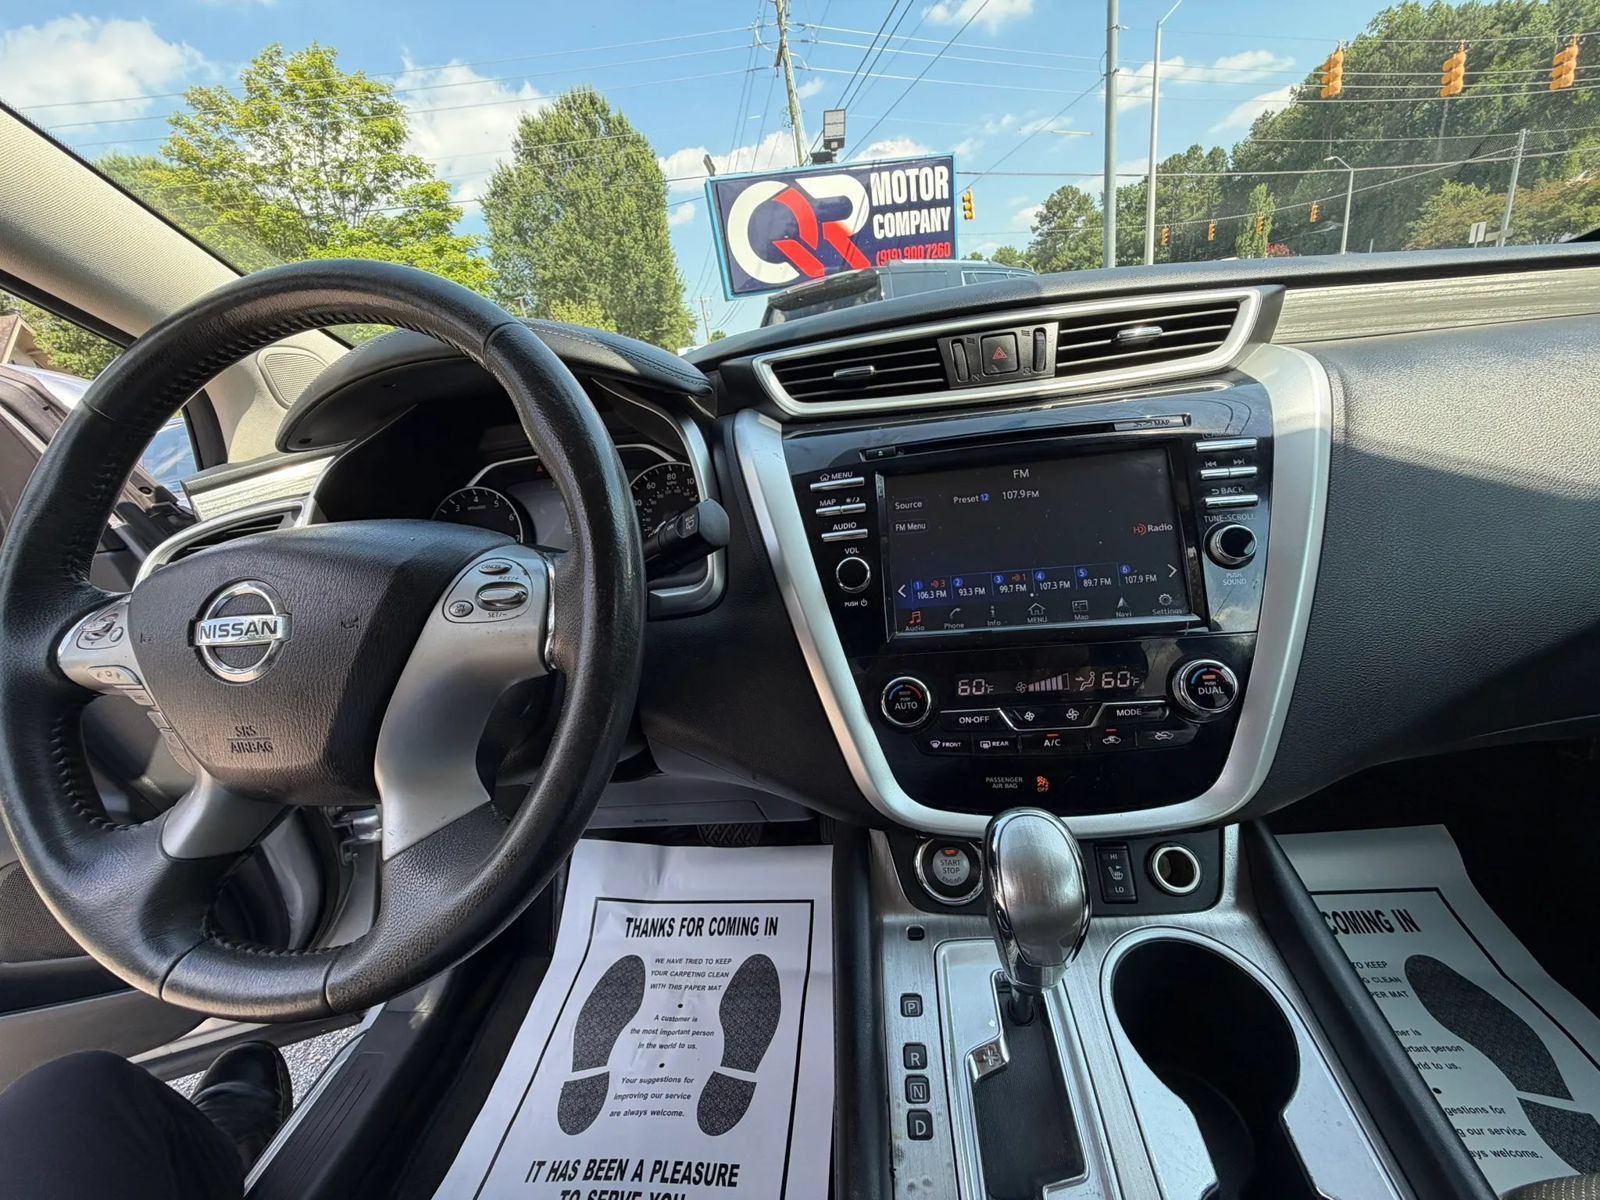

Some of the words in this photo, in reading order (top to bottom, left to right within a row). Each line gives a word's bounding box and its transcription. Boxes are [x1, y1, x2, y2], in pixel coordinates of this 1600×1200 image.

[870, 166, 949, 207] MOTOR
[873, 206, 952, 240] COMPANY
[925, 241, 952, 259] 7260
[666, 472, 676, 480] 80
[831, 472, 854, 480] MENU
[1013, 468, 1030, 479] FM
[1220, 486, 1244, 494] BACK
[953, 494, 979, 504] Preset
[456, 504, 460, 512] 3
[894, 500, 922, 510] Source
[832, 522, 857, 530] AUDIO
[895, 522, 906, 531] FM
[907, 522, 926, 530] Menu
[1147, 523, 1173, 532] Radio
[1100, 578, 1112, 586] FM
[1125, 576, 1144, 584] 107.9
[1145, 574, 1157, 582] FM
[1015, 584, 1027, 592] FM
[1040, 582, 1058, 590] 107.3
[1060, 581, 1070, 589] FM
[936, 590, 947, 598] FM
[959, 588, 973, 596] 93.3
[1152, 608, 1182, 616] Settings
[199, 620, 278, 640] NISSAN
[1198, 686, 1224, 695] DUAL
[894, 702, 917, 710] AUTO
[235, 725, 256, 737] SRS
[230, 741, 274, 753] AIRBAG
[1044, 739, 1061, 747] A/C
[1320, 909, 1395, 936] COMING
[1390, 908, 1422, 933] IN
[625, 917, 675, 938] THANKS
[678, 916, 704, 937] FOR
[708, 916, 760, 937] COMING
[764, 916, 778, 936] IN
[908, 1002, 916, 1014] P
[660, 1028, 690, 1037] important
[1410, 1028, 1422, 1036] is
[1430, 1045, 1464, 1054] person
[910, 1052, 921, 1066] R
[1431, 1062, 1443, 1070] to
[639, 1077, 682, 1085] suggestions
[913, 1085, 923, 1098] N
[614, 1092, 648, 1101] improving
[623, 1109, 648, 1117] always
[650, 1109, 684, 1117] welcome.
[1444, 1106, 1489, 1116] gestions
[1489, 1105, 1506, 1114] for
[915, 1120, 926, 1136] D
[1467, 1128, 1485, 1136] our
[1488, 1126, 1527, 1136] service
[1489, 1148, 1544, 1158] welcome.
[524, 1160, 547, 1184] IT
[545, 1159, 581, 1183] HAS
[582, 1158, 629, 1182] BEEN
[630, 1159, 645, 1183] A
[649, 1160, 740, 1188] PLEASURE
